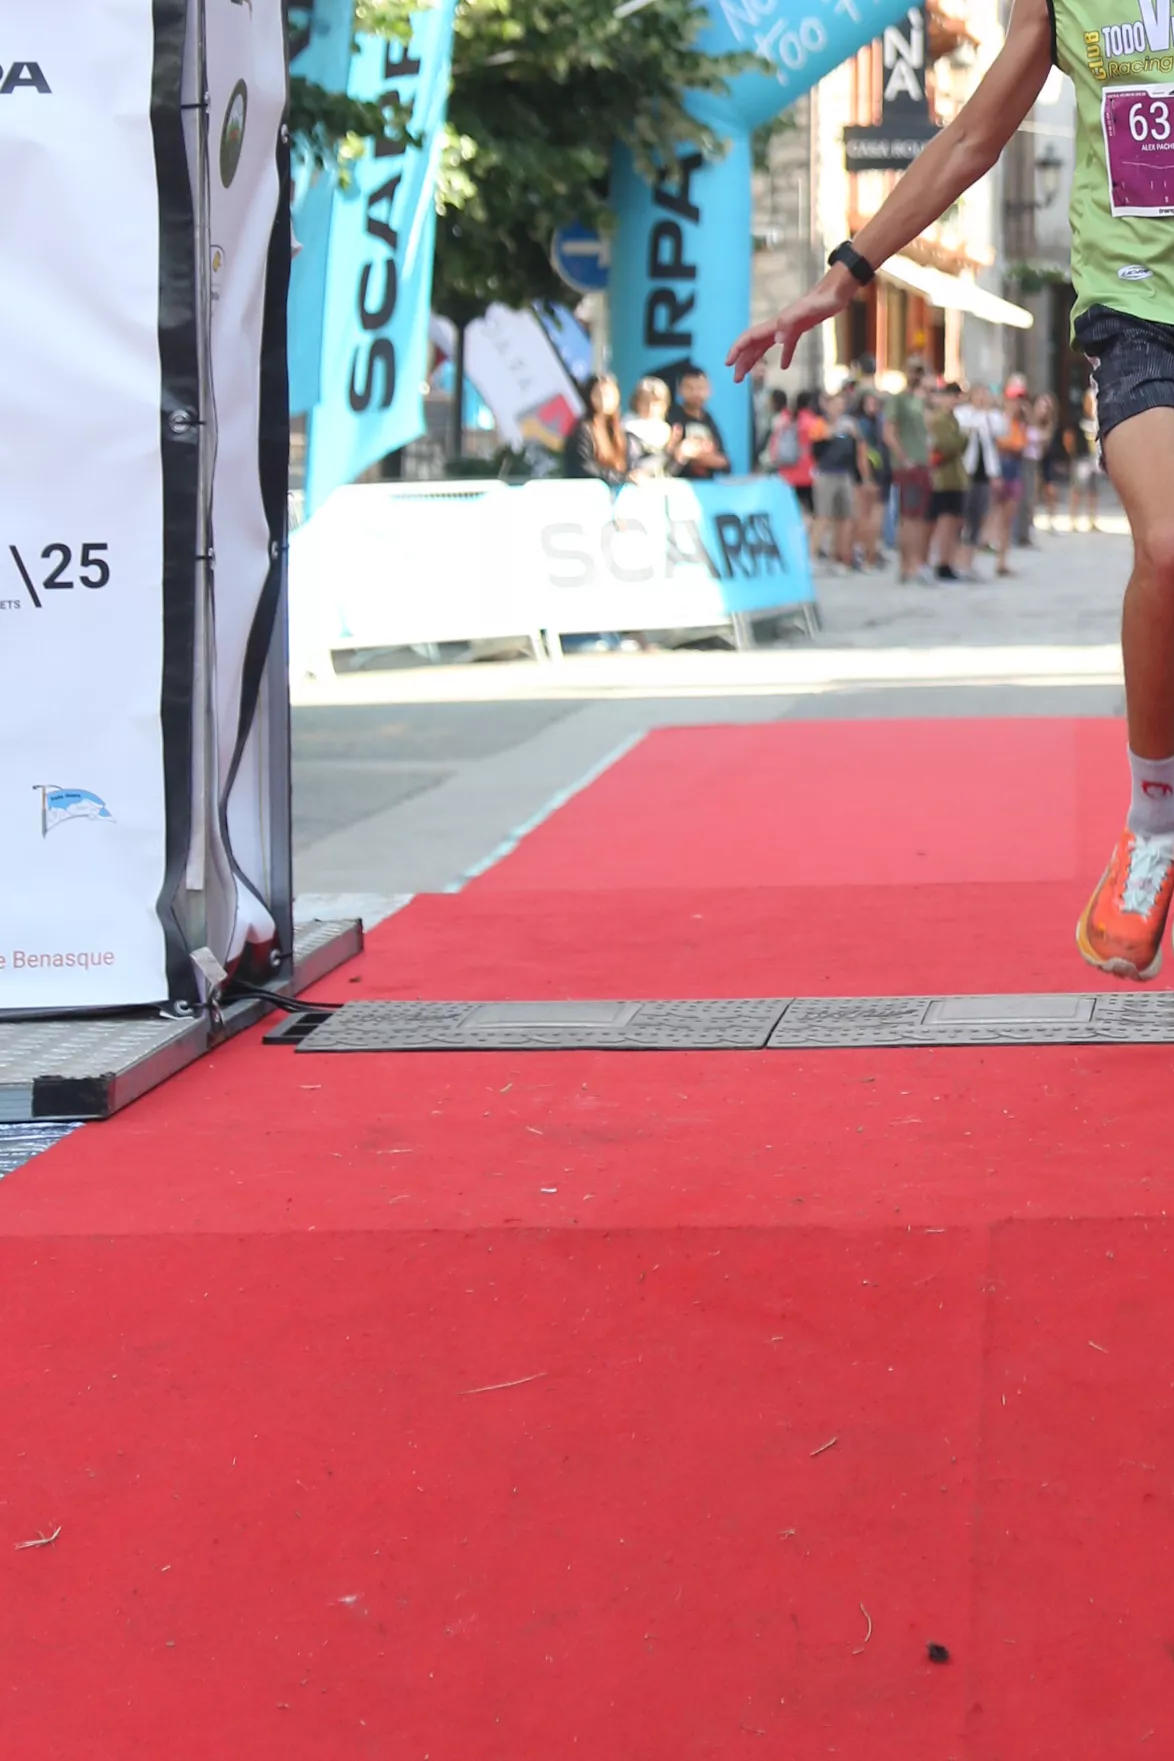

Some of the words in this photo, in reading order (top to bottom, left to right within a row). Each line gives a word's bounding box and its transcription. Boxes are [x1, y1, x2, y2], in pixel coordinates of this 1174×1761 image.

[1108, 54, 1174, 79] Racing
[1141, 143, 1155, 152] ALEX
[13, 950, 115, 971] Benasque
